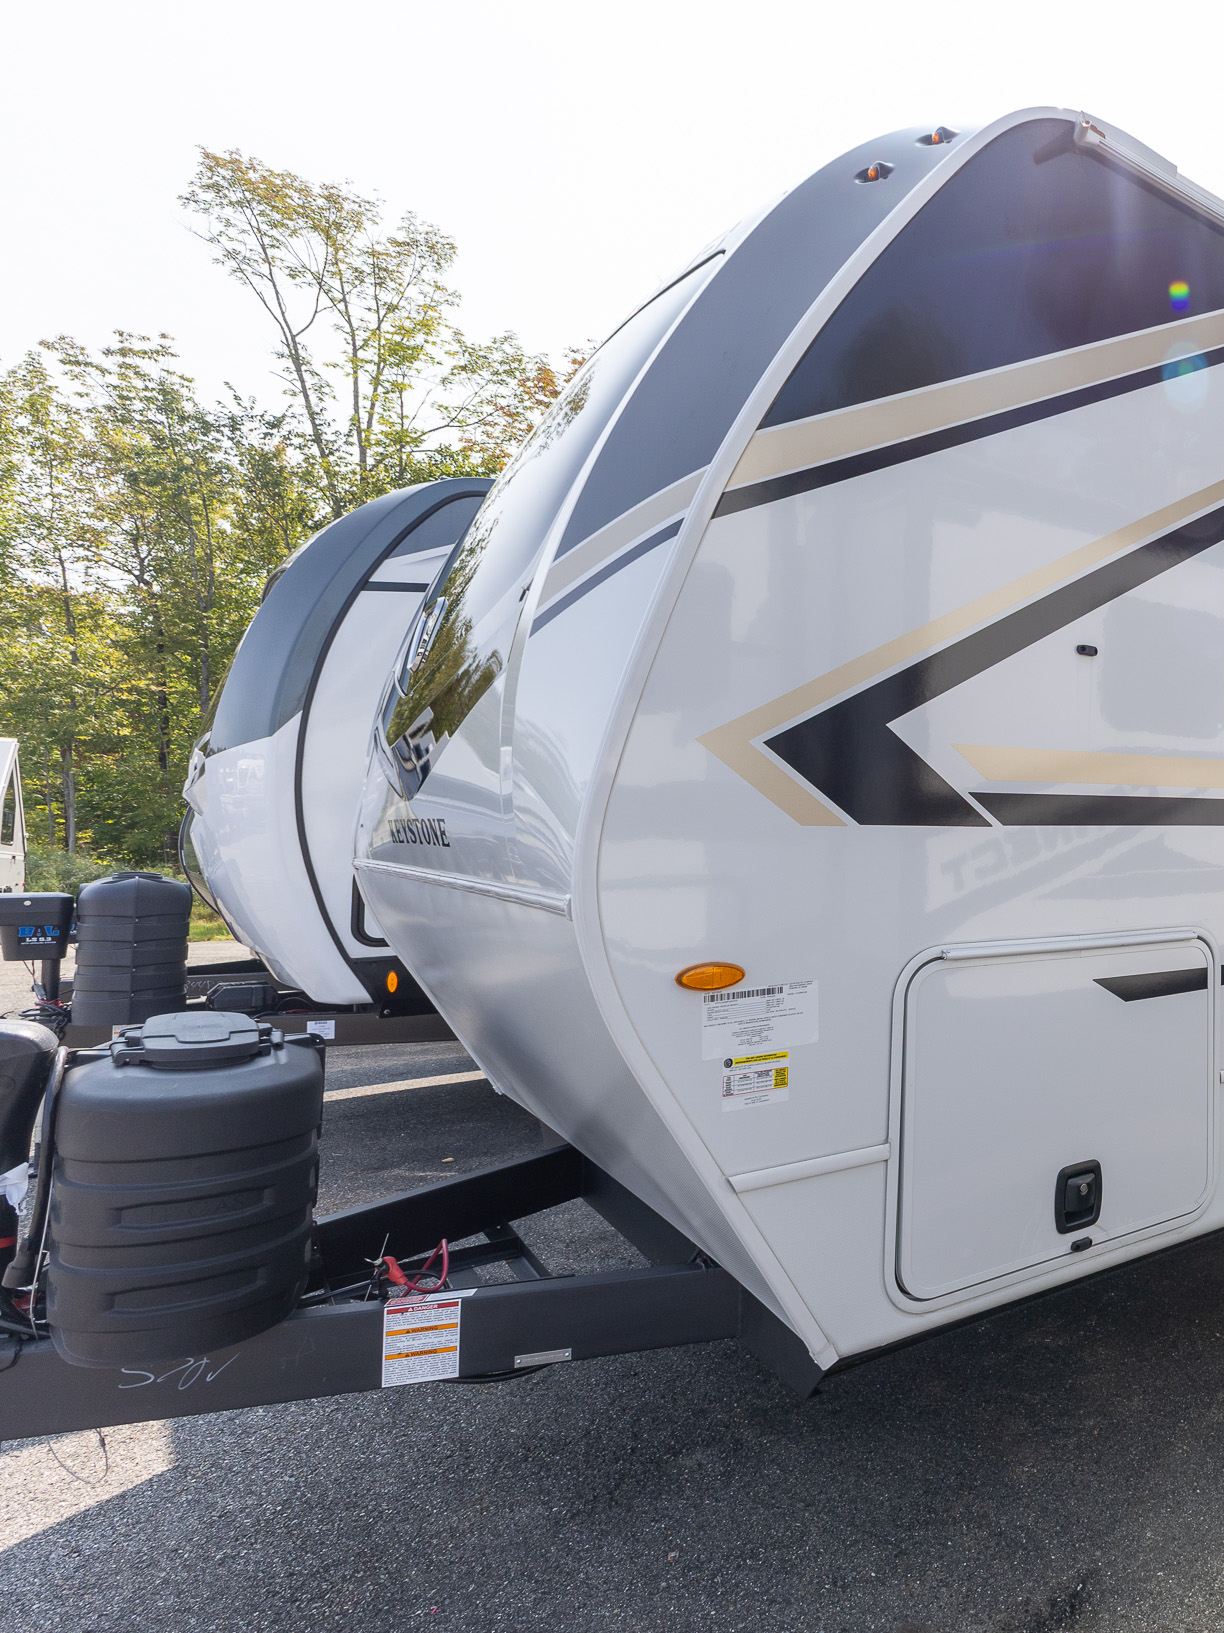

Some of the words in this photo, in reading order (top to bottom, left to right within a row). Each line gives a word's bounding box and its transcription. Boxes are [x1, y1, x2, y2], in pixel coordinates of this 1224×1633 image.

[388, 819, 451, 847] KEYSTONE
[412, 1325, 438, 1333] WARNING
[411, 1349, 438, 1357] WARNING
